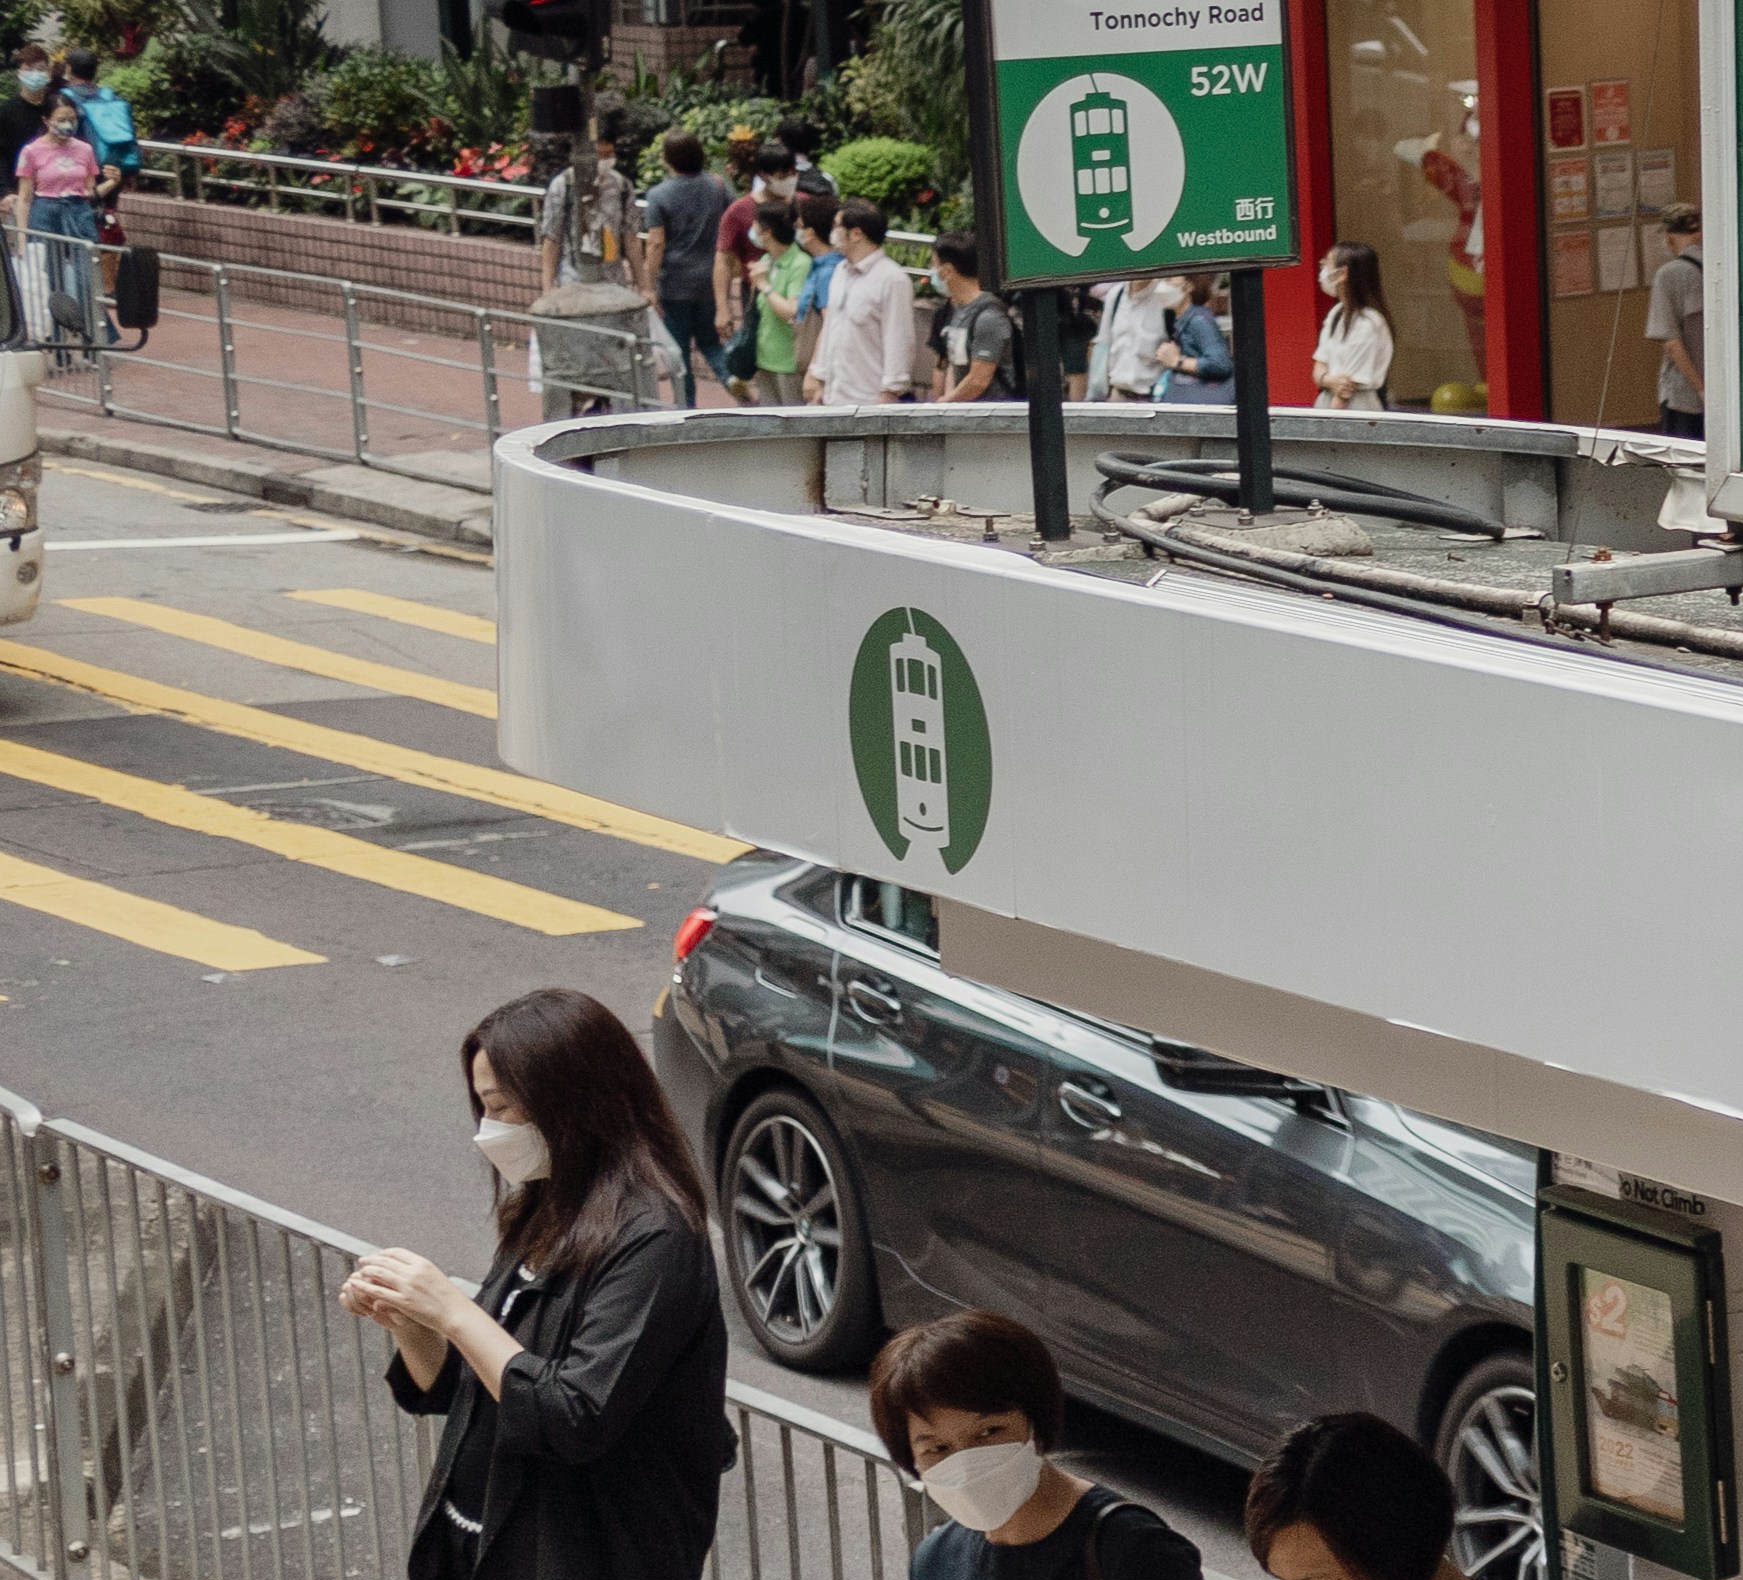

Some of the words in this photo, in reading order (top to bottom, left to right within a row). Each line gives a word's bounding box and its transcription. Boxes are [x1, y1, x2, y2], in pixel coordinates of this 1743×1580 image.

[1090, 6, 1200, 30] Tonnochy
[1209, 3, 1264, 24] Road
[1190, 62, 1268, 96] 52W
[1235, 197, 1275, 221] 西行
[1177, 225, 1276, 248] Westbound
